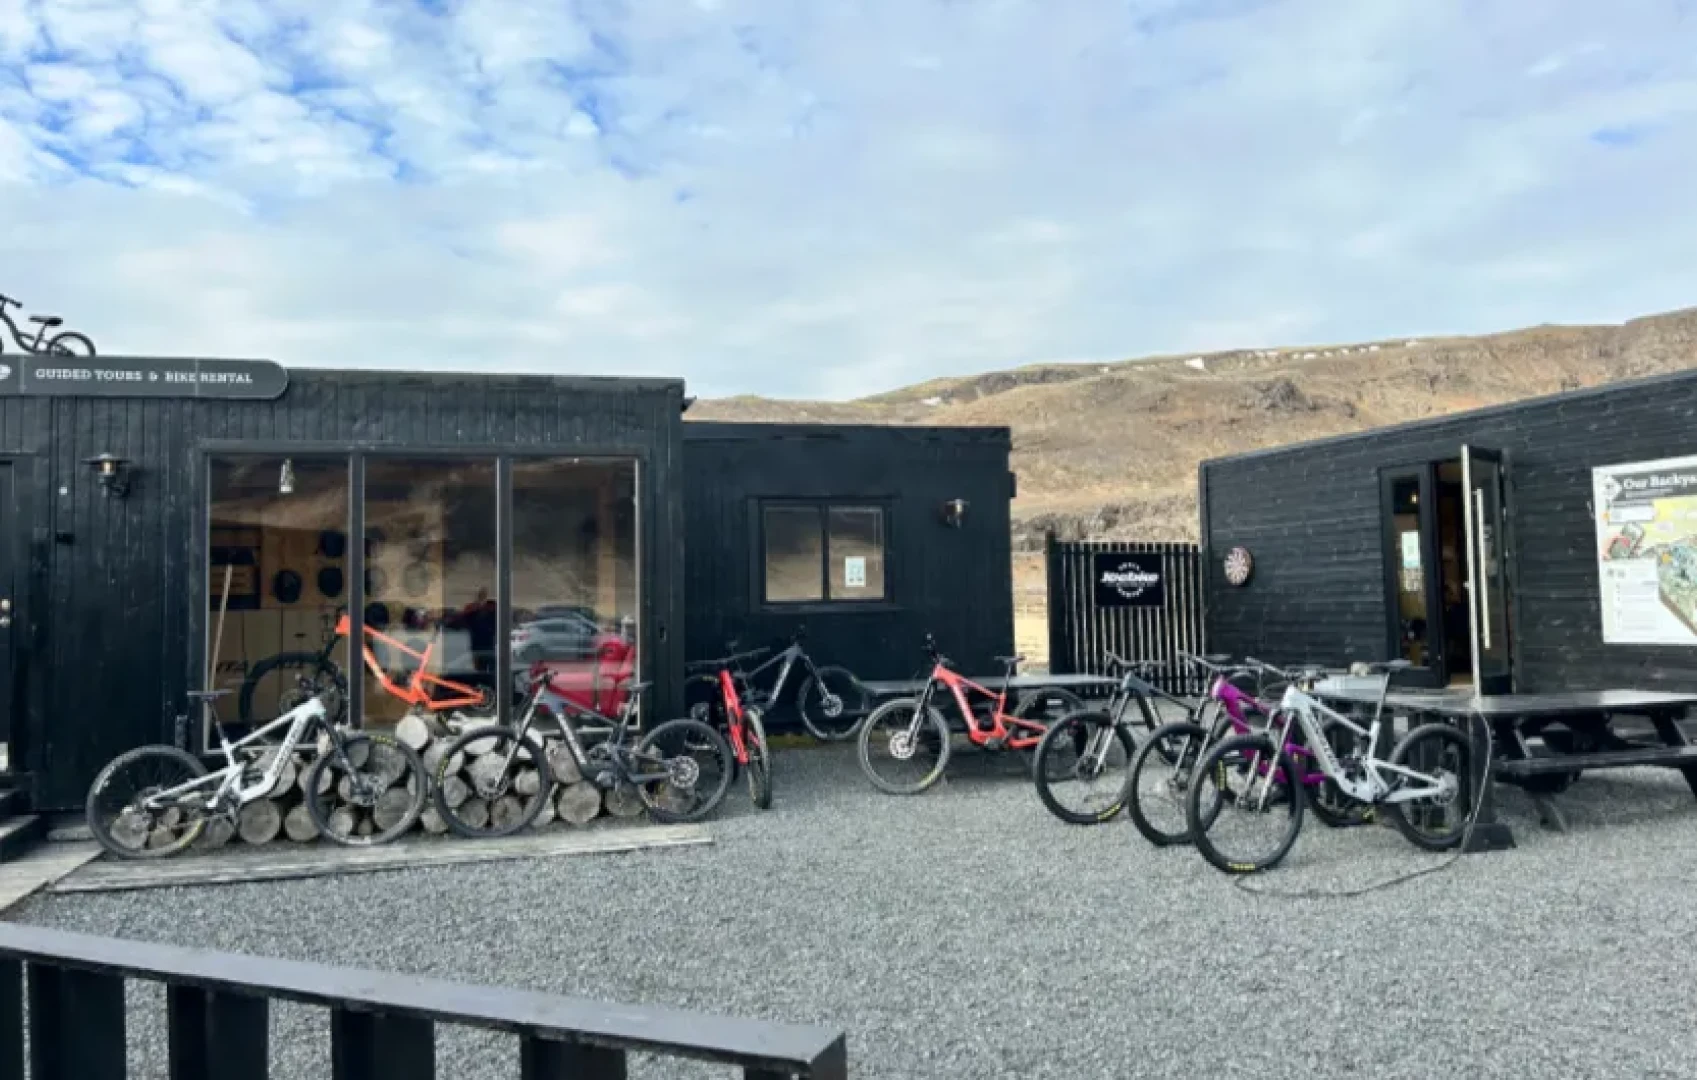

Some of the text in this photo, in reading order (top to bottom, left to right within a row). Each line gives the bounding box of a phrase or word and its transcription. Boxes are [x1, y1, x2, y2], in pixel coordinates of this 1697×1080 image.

[35, 368, 253, 384] GUIDED TOURS & BIKE RENTAL
[1623, 478, 1648, 489] Our
